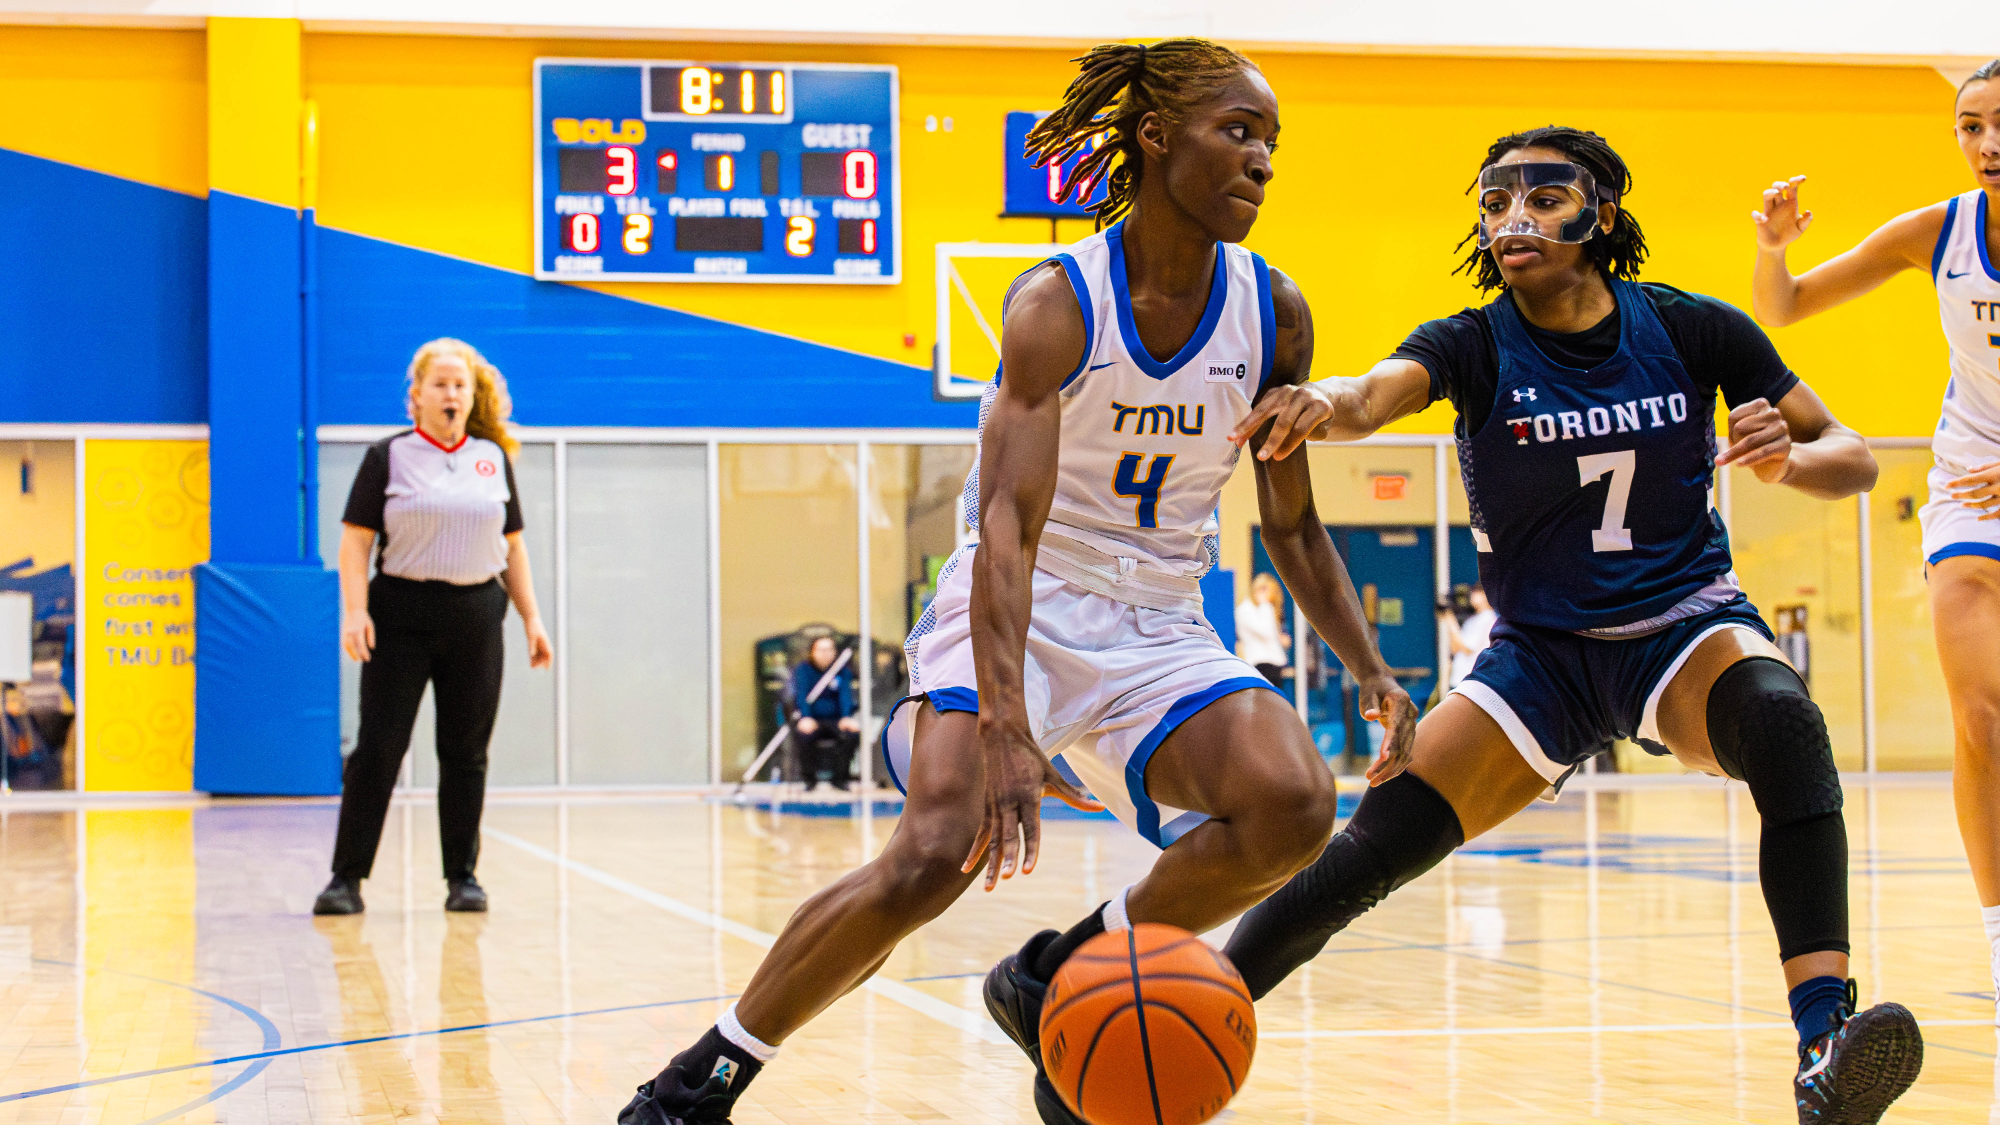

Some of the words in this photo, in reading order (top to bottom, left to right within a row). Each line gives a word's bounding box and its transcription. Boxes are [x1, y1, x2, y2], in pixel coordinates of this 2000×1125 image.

[681, 66, 785, 115] 8:11
[802, 123, 873, 148] GUEST
[606, 146, 637, 196] 3
[718, 154, 734, 191] 1
[844, 149, 877, 199] 0
[570, 212, 600, 253] 0
[622, 213, 653, 255] 2
[785, 215, 816, 257] 2
[861, 218, 878, 254] 1
[1208, 366, 1234, 376] BMO
[1110, 400, 1205, 436] TMU
[1506, 392, 1688, 446] TORONTO
[1111, 450, 1177, 528] 4
[1576, 449, 1636, 552] 7
[103, 592, 181, 607] comes
[105, 617, 153, 636] first
[104, 646, 161, 667] TMU
